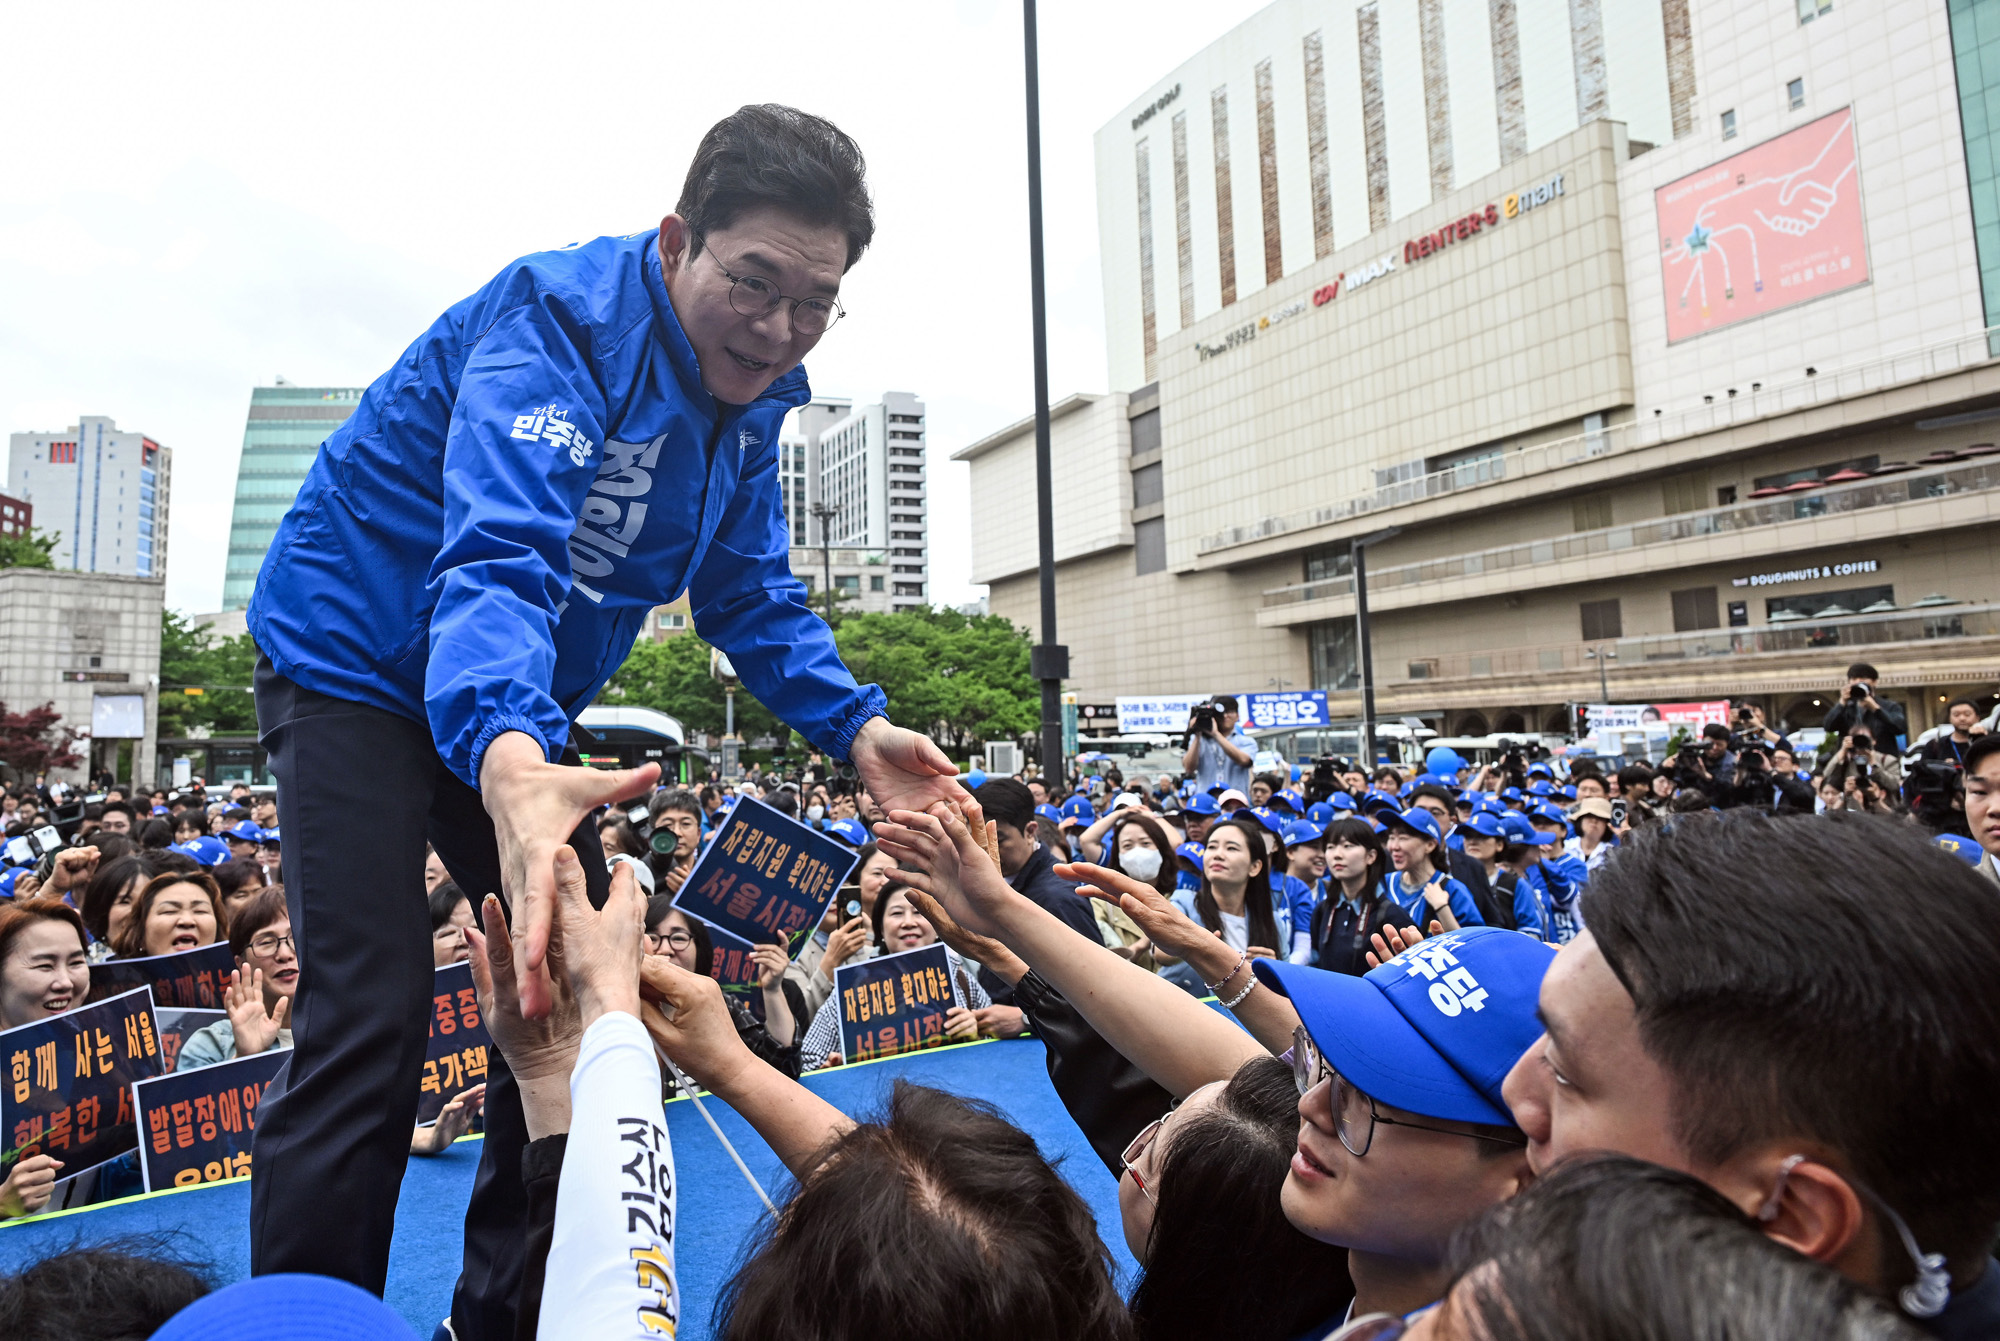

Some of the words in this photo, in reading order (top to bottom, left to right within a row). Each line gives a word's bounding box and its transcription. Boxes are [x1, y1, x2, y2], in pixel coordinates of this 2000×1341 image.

[1504, 173, 1565, 219] emart
[1313, 281, 1339, 307] CGV
[1346, 254, 1397, 291] IMAX
[533, 403, 568, 420] 더불어
[510, 415, 594, 467] 민주당
[1750, 567, 1820, 587] DOUGHNUTS
[1822, 565, 1832, 577] &
[1833, 560, 1877, 576] COFFEE
[1251, 700, 1321, 726] 정원오
[722, 820, 791, 879] 자립지원
[787, 851, 835, 904] 확대하는
[710, 946, 763, 988] 함께하
[1387, 940, 1490, 1018] 민주당
[429, 987, 480, 1038] 중증
[844, 978, 896, 1023] 자립지원
[901, 967, 950, 1009] 확대하는
[11, 1041, 58, 1104] 함께
[75, 1027, 114, 1078] 사는
[124, 1011, 157, 1060] 서울
[14, 1095, 101, 1161] 행복한
[149, 1081, 272, 1155] 발달장애인
[617, 1117, 673, 1244] 김승식
